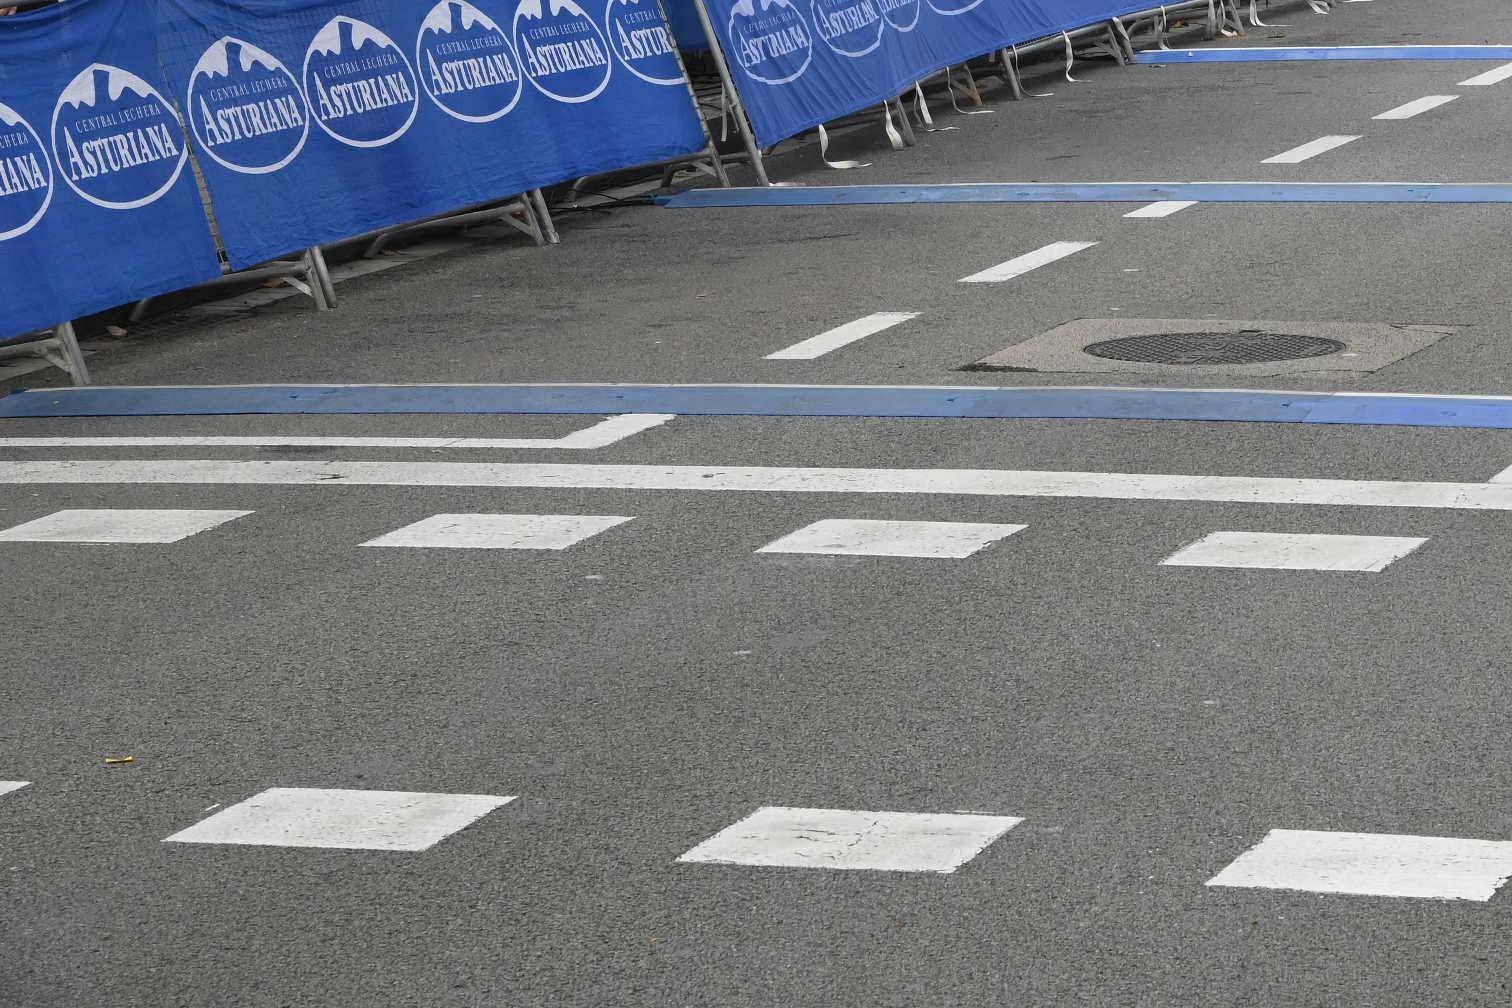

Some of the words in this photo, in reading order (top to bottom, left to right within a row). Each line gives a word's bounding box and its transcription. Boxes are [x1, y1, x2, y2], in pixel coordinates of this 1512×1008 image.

[521, 32, 607, 78] ASTURIANA
[615, 17, 676, 61] ASTUR
[314, 71, 414, 121] ASTURIANA
[427, 47, 518, 96] ASTURIANA
[75, 112, 117, 134] CENTRAL
[119, 103, 161, 124] LECHERA
[200, 94, 303, 147] ASTURIANA
[64, 123, 179, 181] ASTURIANA
